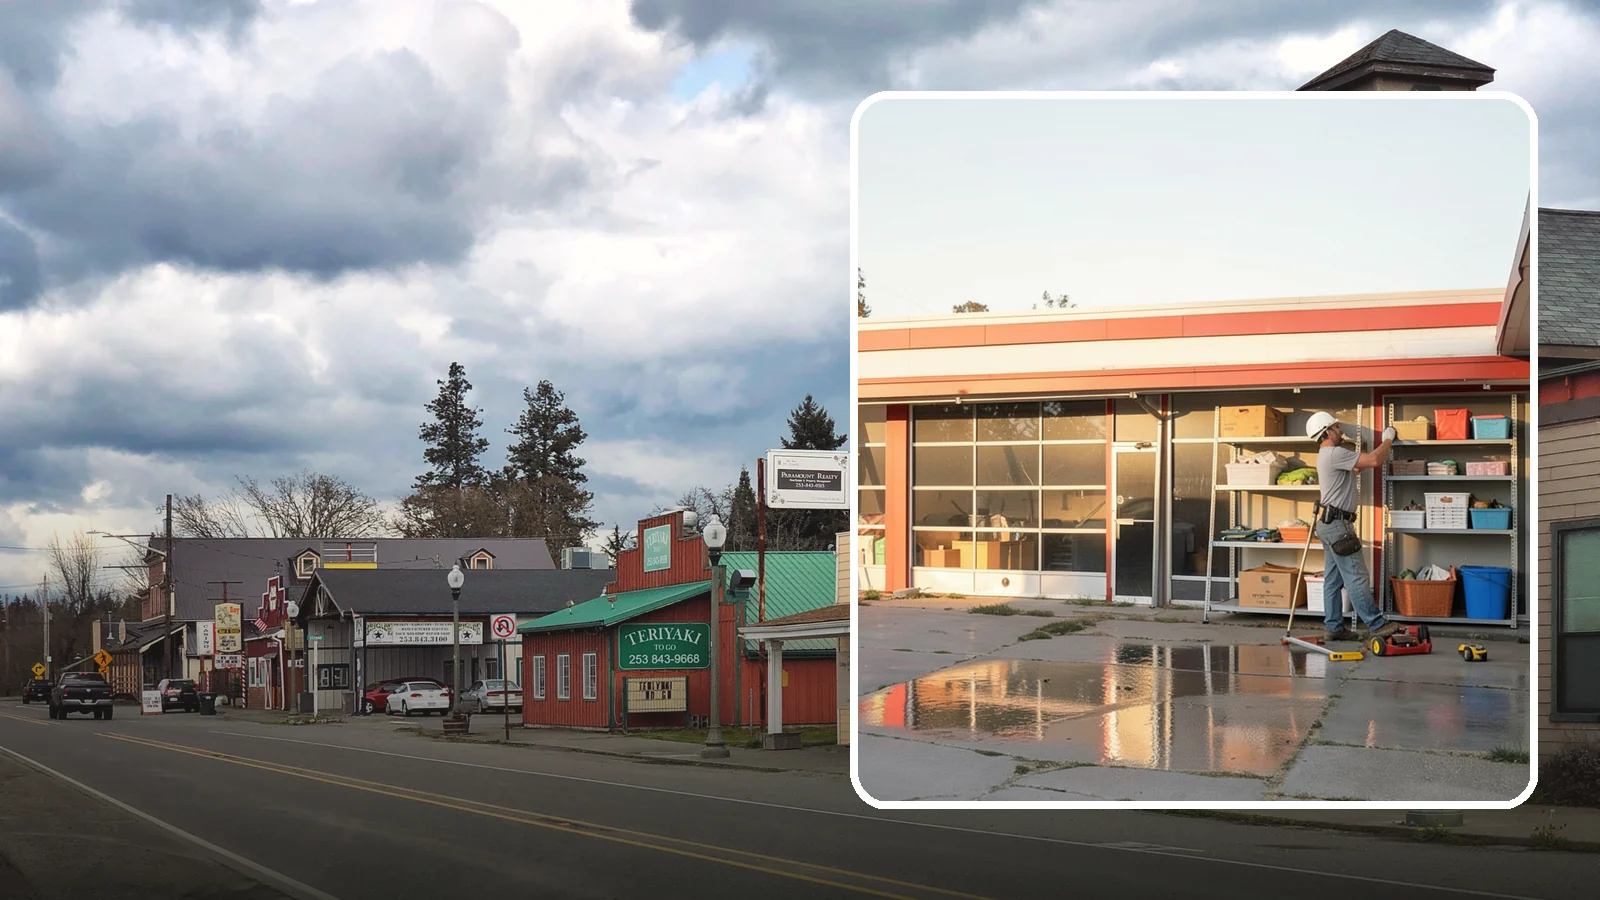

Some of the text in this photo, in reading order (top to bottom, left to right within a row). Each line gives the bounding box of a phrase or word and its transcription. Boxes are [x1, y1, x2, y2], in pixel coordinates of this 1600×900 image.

[781, 471, 838, 480] PARAMOUNT REALTY
[625, 627, 702, 646] TERIYAKI
[629, 654, 700, 665] 253 843-9668
[638, 681, 673, 691] TERIYAKI
